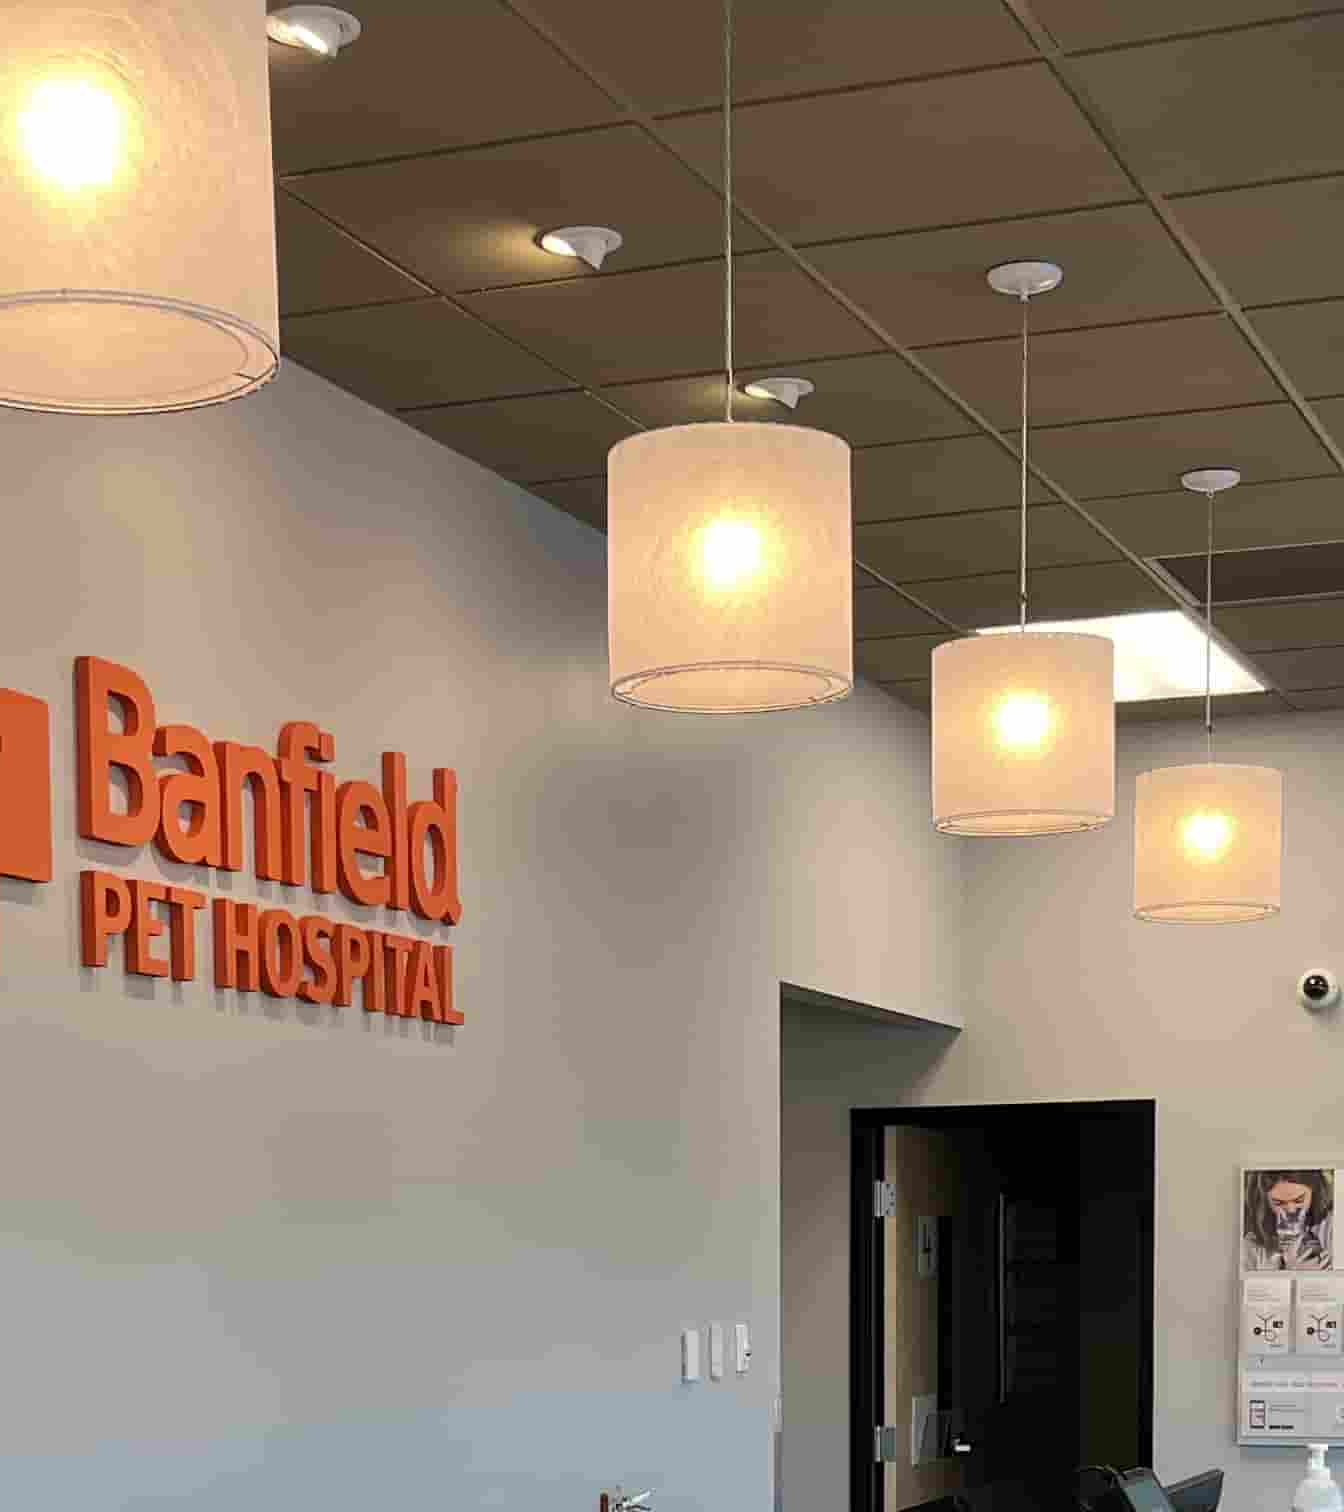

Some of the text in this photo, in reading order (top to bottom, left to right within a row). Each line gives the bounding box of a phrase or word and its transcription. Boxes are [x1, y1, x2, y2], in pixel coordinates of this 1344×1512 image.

[75, 655, 462, 924] Banfield
[79, 870, 464, 1025] PET HOSPITAL
